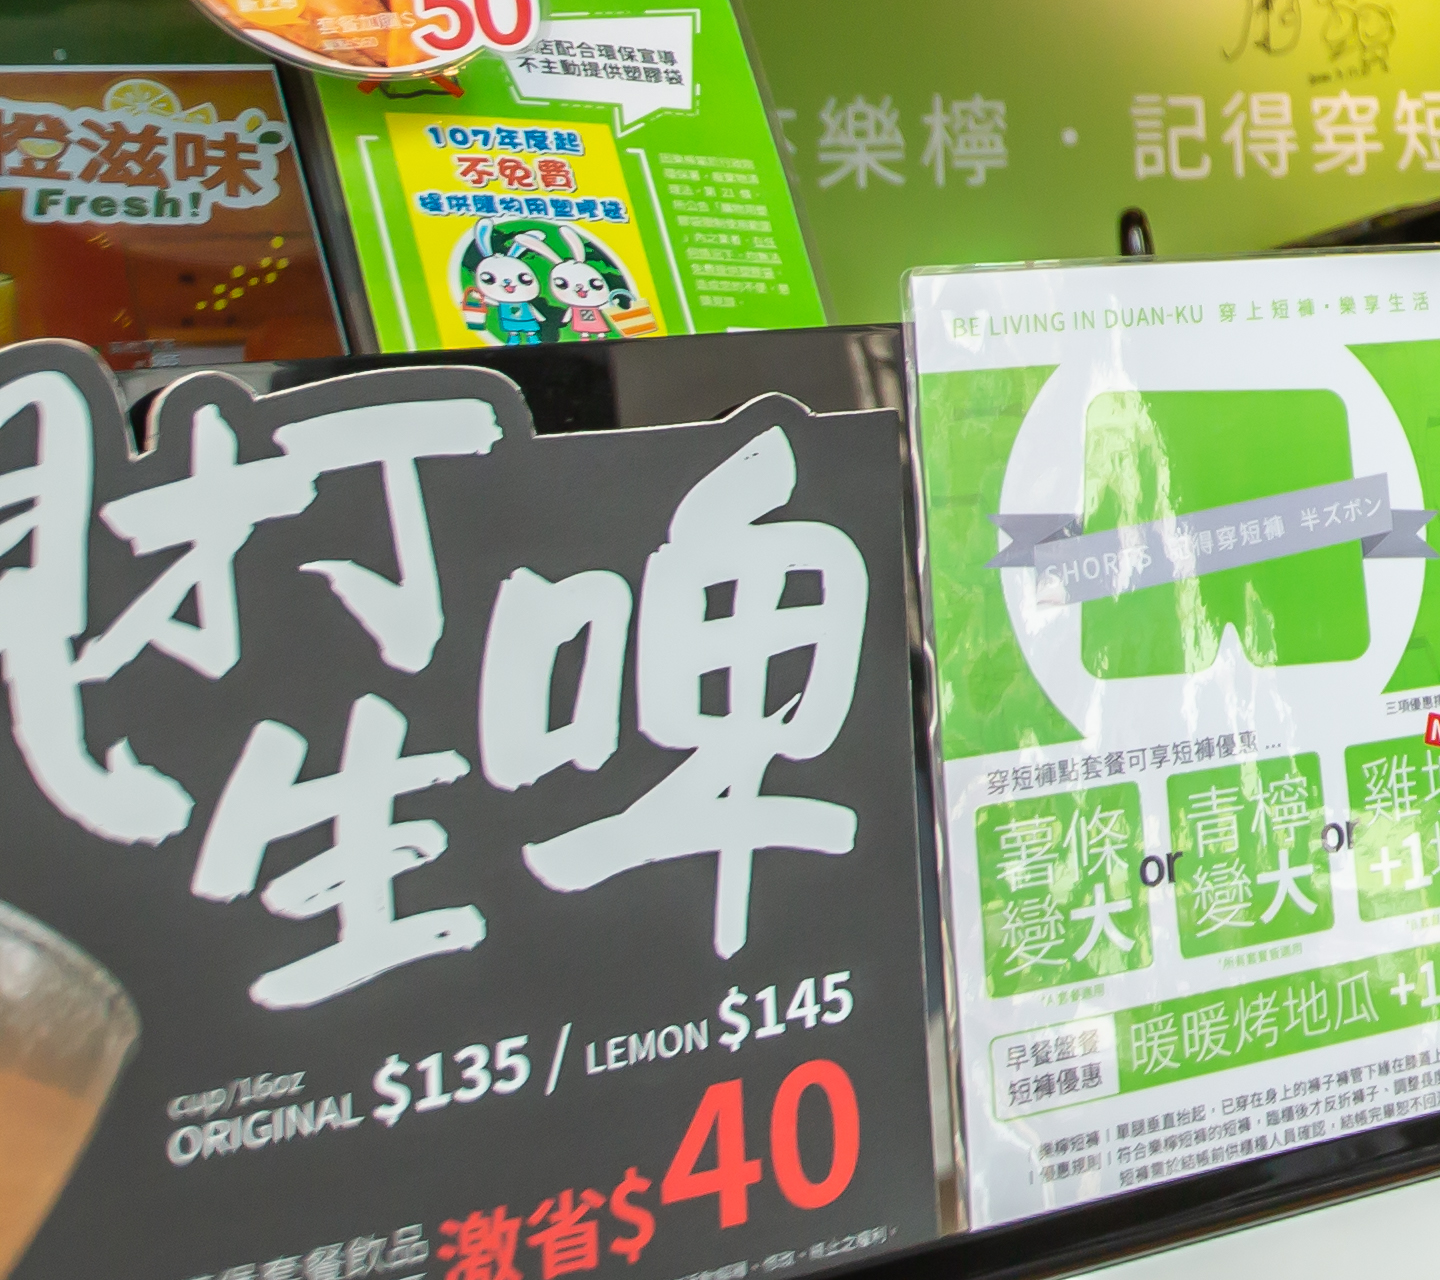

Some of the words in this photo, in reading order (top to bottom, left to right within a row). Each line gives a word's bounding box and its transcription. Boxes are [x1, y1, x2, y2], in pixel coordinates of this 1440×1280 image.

[536, 39, 679, 68] 店配合環保宣導
[426, 125, 585, 155] 107年度起
[455, 155, 577, 193] 不免費
[33, 188, 204, 219] Fresh!
[952, 316, 982, 338] BE
[990, 309, 1066, 337] LIVING
[1073, 309, 1096, 331] IN
[1104, 303, 1204, 329] DUAN-KU
[1187, 772, 1311, 858] 青檸
[994, 804, 1129, 892] 薯條
[1139, 850, 1184, 888] or
[1191, 847, 1318, 939] 變大
[1000, 882, 1136, 978] 變大
[1130, 971, 1379, 1077] 暖暖烤地瓜
[166, 1093, 366, 1168] ORIGINAL
[372, 1034, 532, 1127] $135
[585, 1018, 709, 1076] LEMON
[717, 970, 854, 1052] $145
[1007, 1061, 1103, 1108] 短褲優惠
